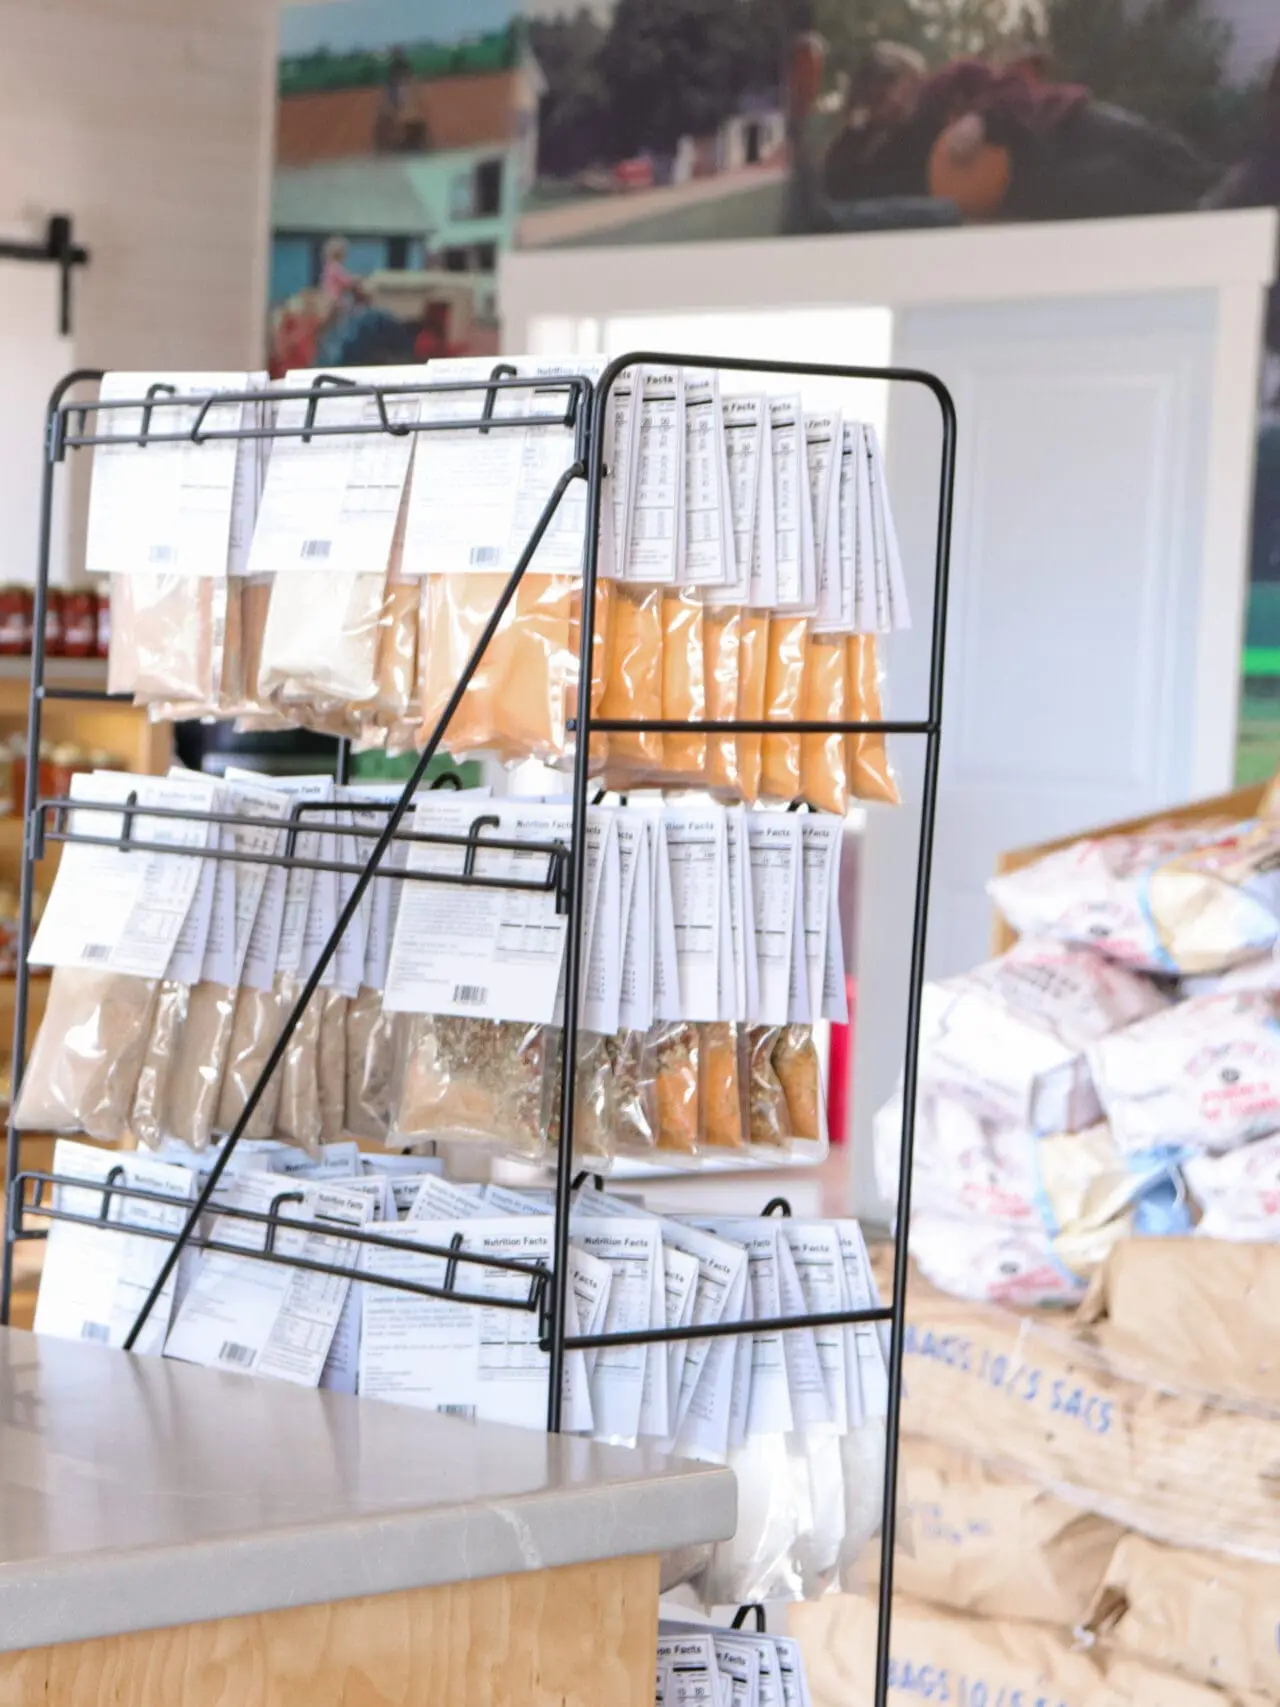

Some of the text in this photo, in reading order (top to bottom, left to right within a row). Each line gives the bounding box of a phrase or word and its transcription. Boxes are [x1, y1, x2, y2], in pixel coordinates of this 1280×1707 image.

[646, 374, 673, 385] Facts
[483, 1236, 549, 1247] Nutrition Facts
[583, 1236, 649, 1247] Nutrition Facts
[573, 1270, 598, 1289] Facts
[1049, 1378, 1114, 1434] SACS
[673, 1644, 702, 1655] Facts
